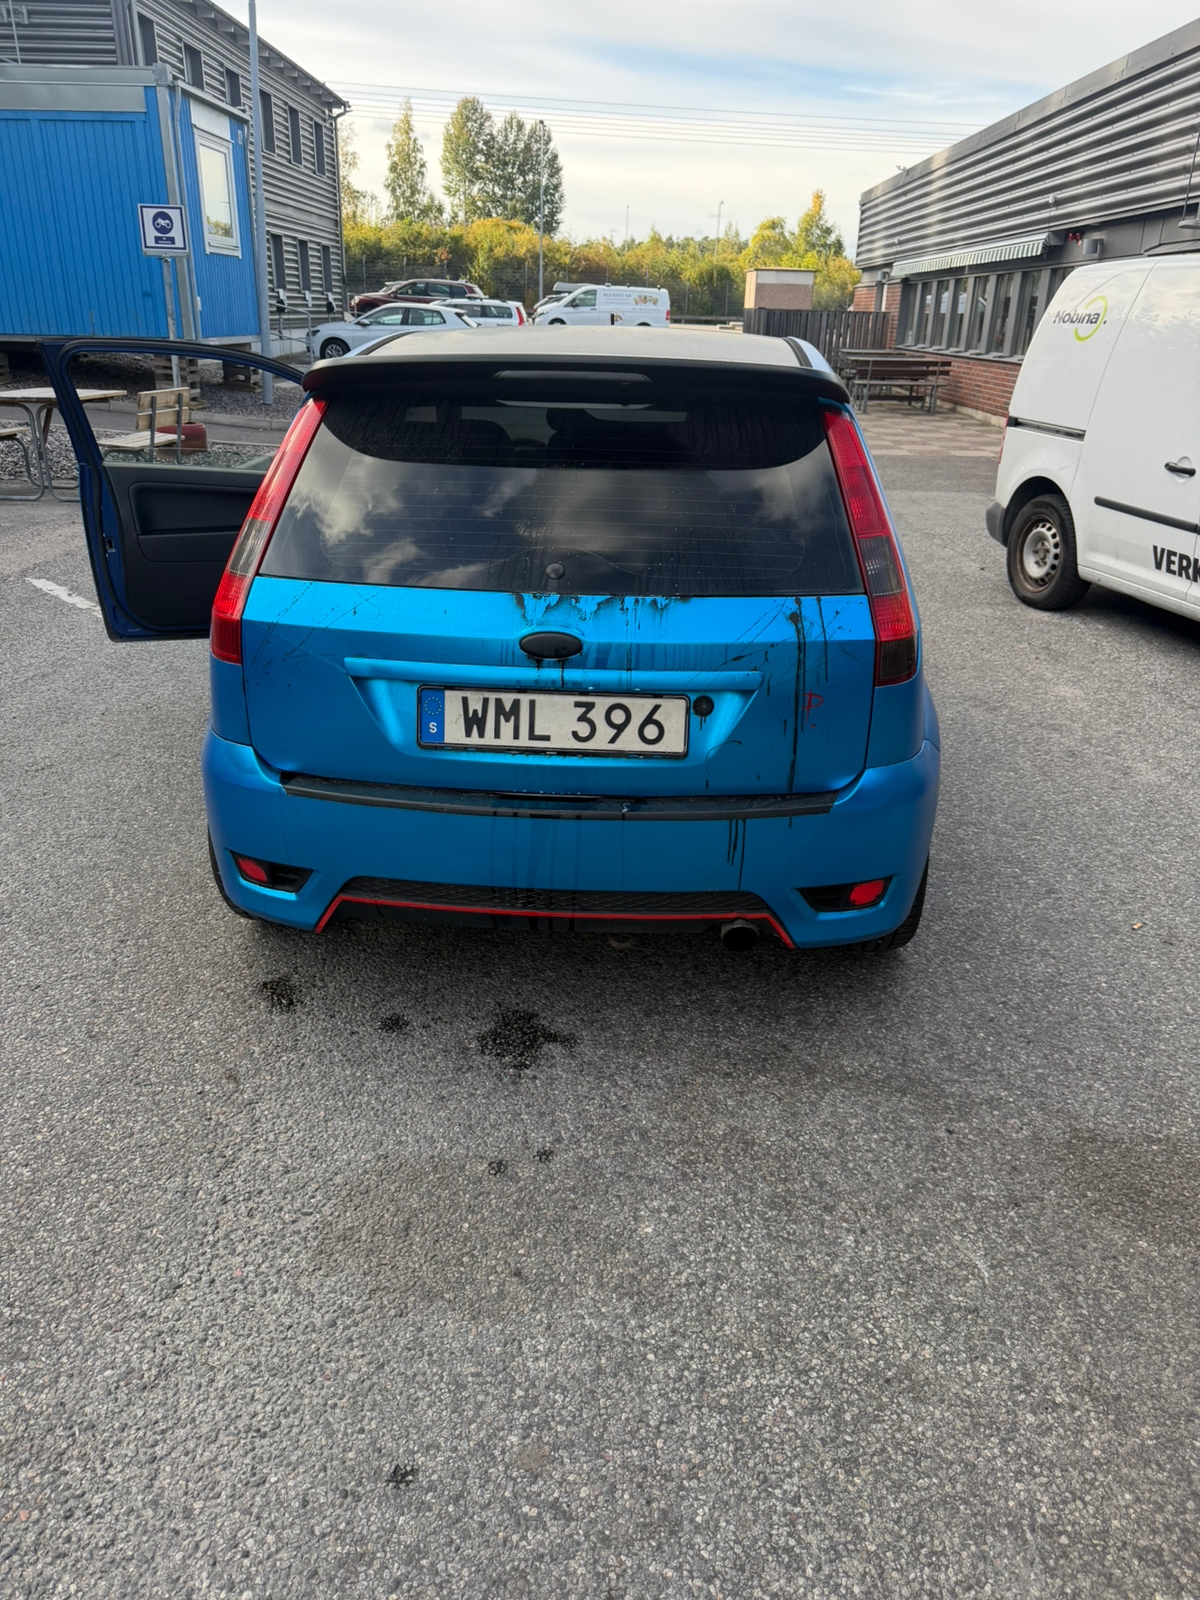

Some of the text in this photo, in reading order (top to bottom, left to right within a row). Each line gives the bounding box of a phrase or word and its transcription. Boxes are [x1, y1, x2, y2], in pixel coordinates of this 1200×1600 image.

[428, 722, 438, 733] S
[461, 696, 665, 745] WML 396
